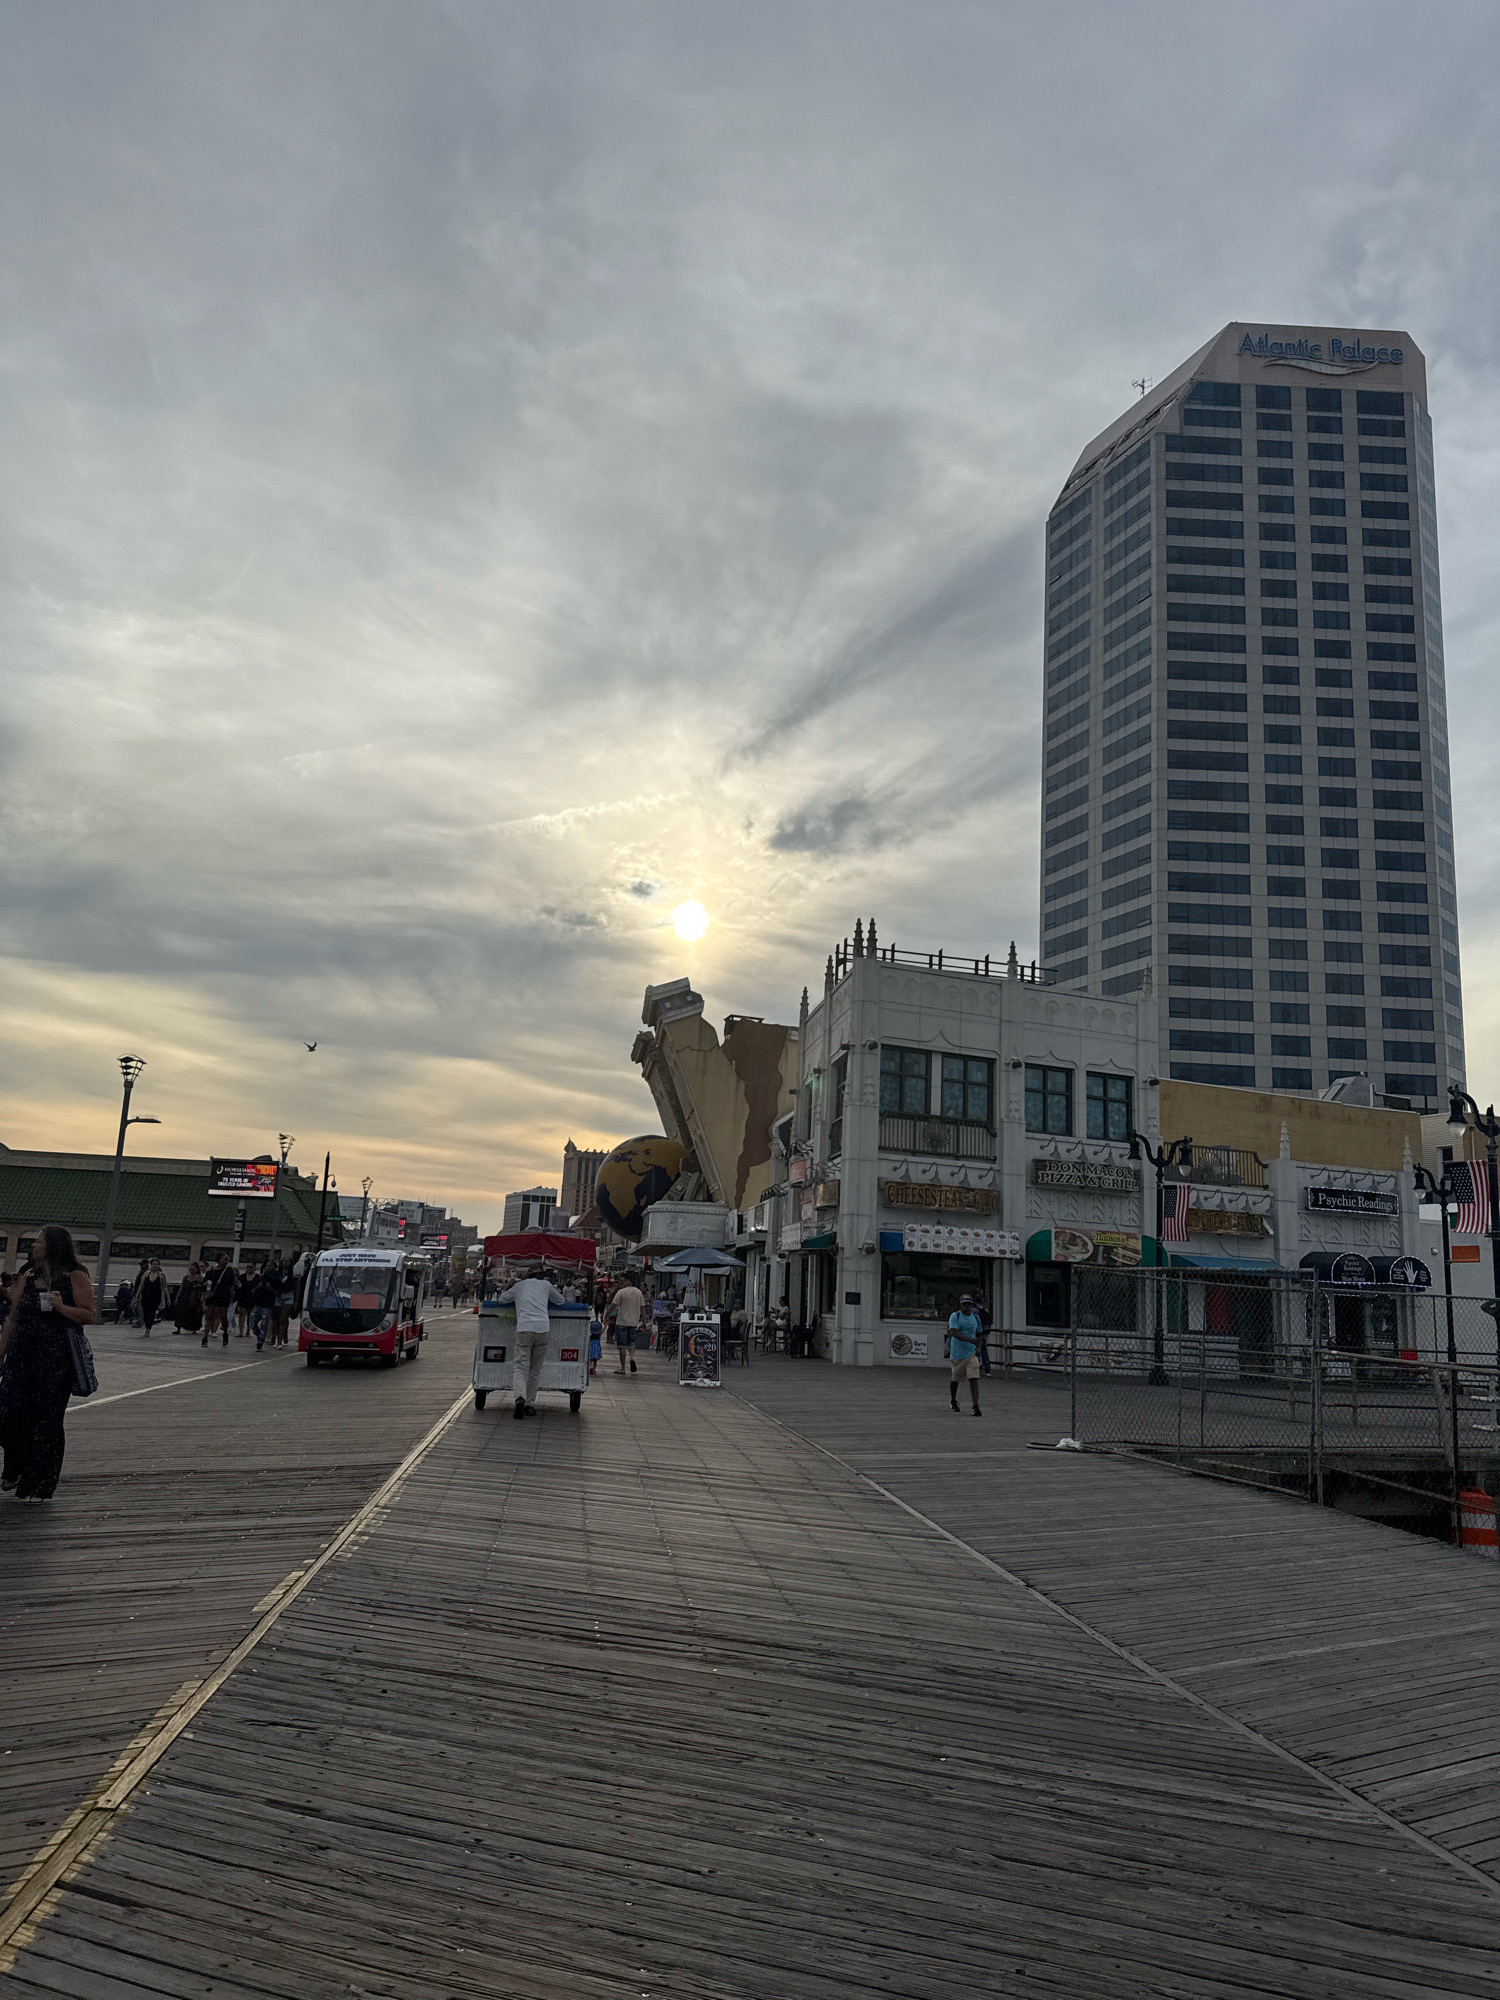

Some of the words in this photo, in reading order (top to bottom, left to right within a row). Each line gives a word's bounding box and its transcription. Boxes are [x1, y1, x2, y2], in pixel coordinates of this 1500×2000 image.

[1239, 333, 1323, 359] Atlantic
[1331, 337, 1404, 363] Palace
[1047, 1161, 1082, 1174] DON
[1085, 1164, 1133, 1179] MACO'S
[1039, 1172, 1084, 1186] PIZZA
[1087, 1176, 1098, 1187] &
[1101, 1178, 1139, 1191] GRILL
[1318, 1193, 1357, 1208] Psychic
[1358, 1196, 1393, 1212] Readings
[562, 1351, 577, 1359] 304
